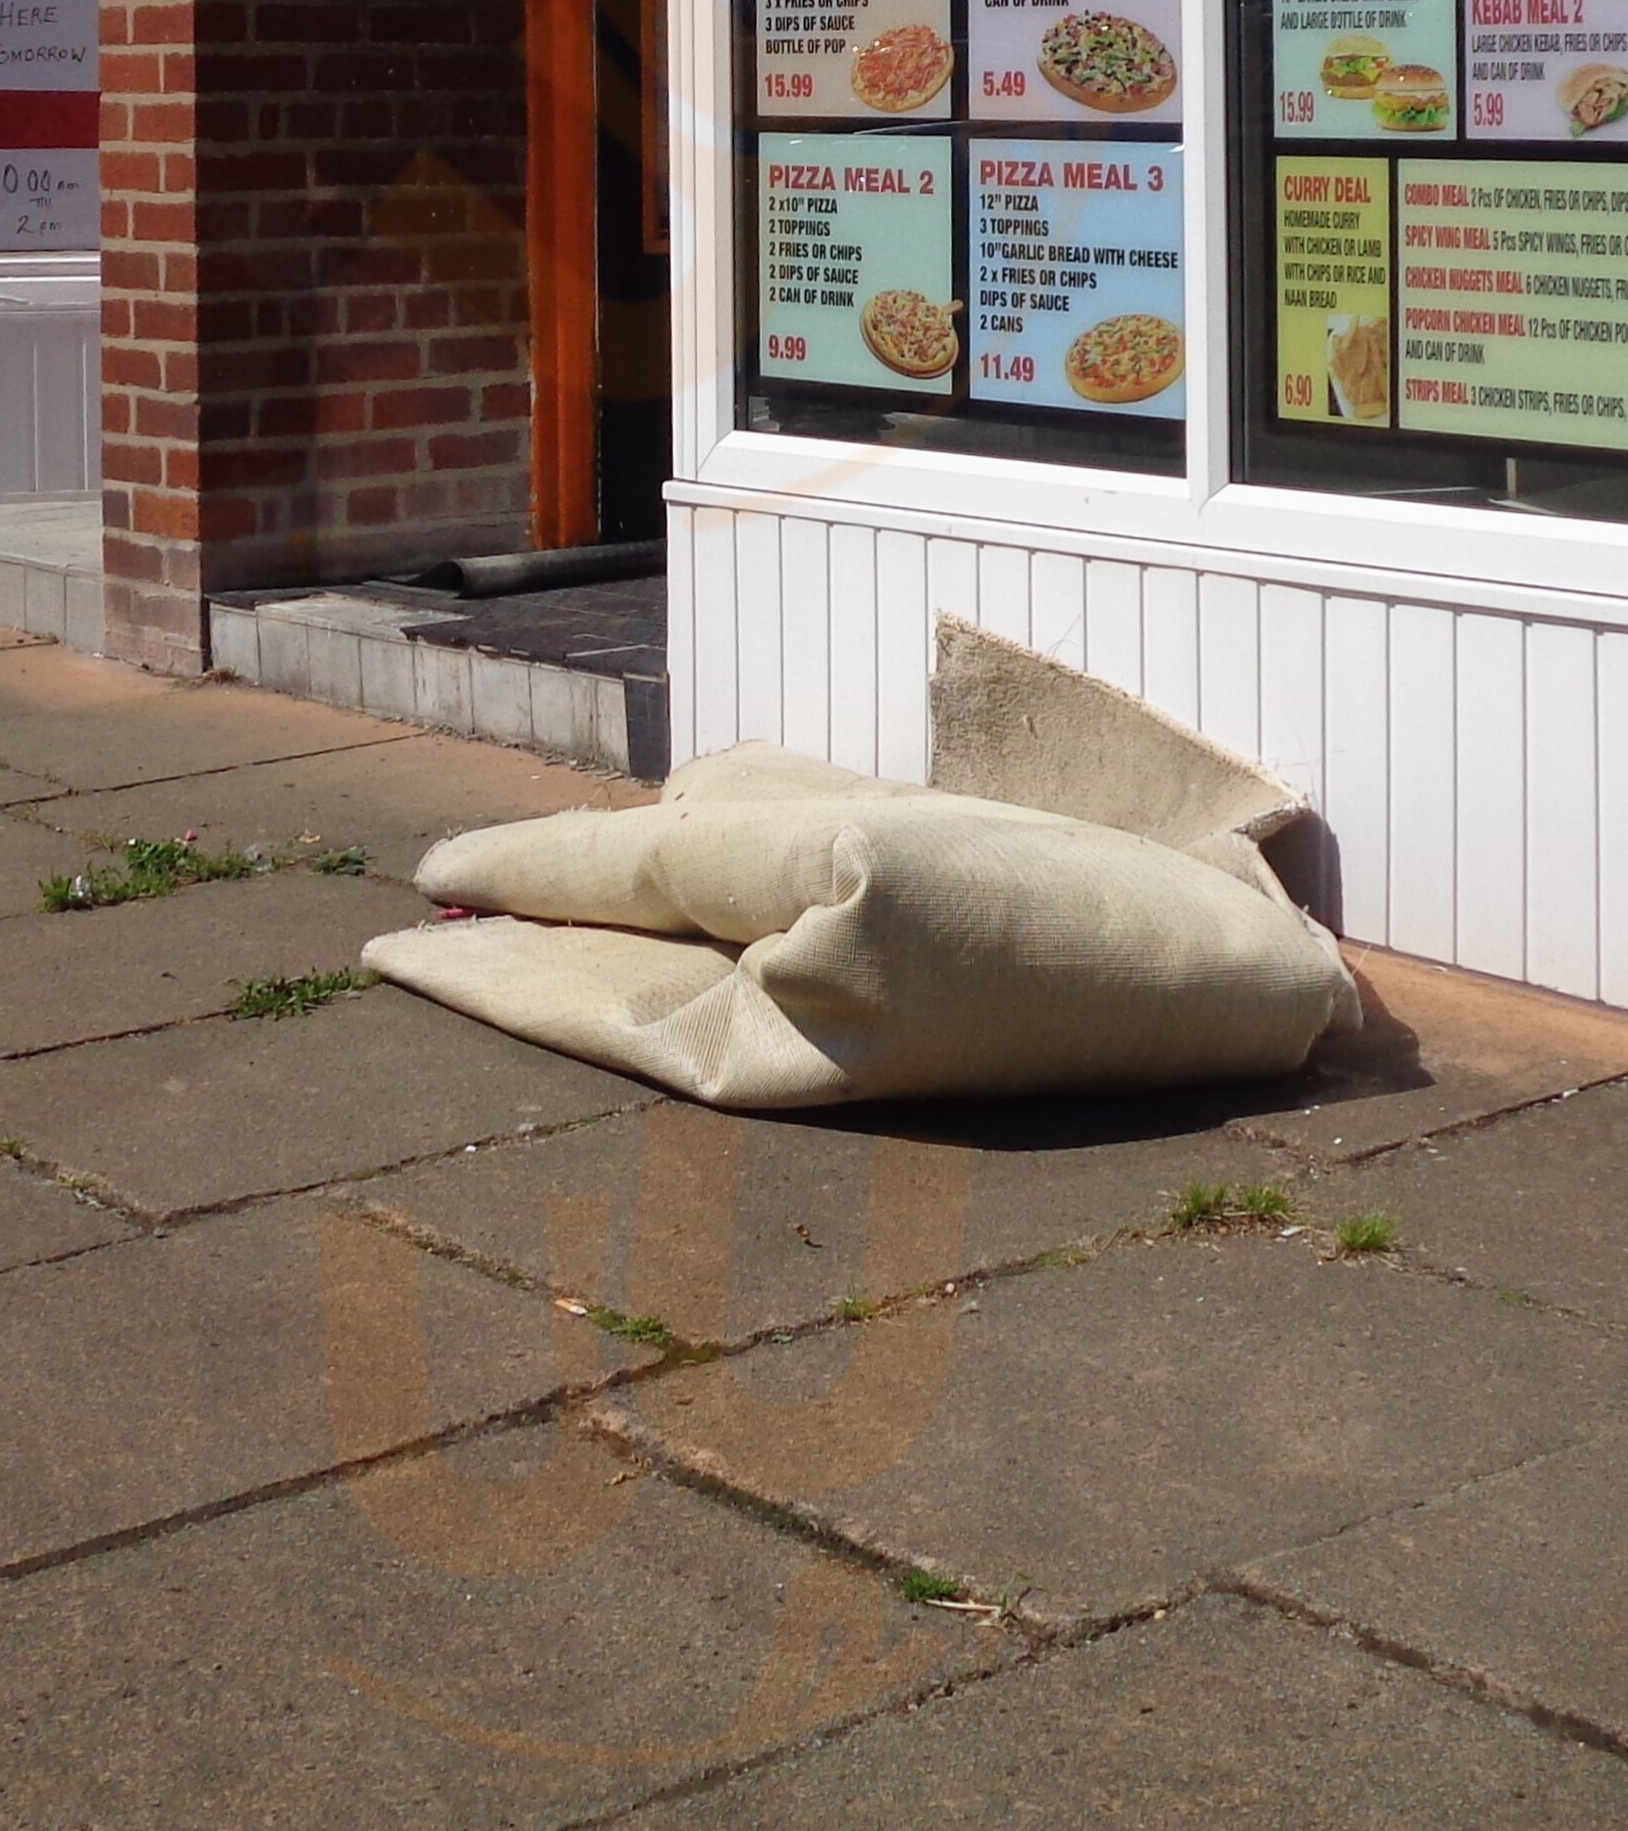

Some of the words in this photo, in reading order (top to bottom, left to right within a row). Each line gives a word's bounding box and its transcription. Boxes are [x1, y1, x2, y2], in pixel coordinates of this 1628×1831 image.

[766, 39, 804, 55] BOTTLE
[807, 39, 822, 54] OF
[824, 38, 846, 54] POP
[764, 73, 813, 98] 15.99
[982, 71, 1025, 97] 5.49
[1279, 90, 1315, 125] 15.99
[1473, 93, 1504, 128] 5.99
[769, 164, 836, 191] PIZZA
[844, 167, 910, 194] MEAL
[919, 170, 934, 195] 2
[980, 160, 1054, 187] PIZZA
[1064, 162, 1137, 190] MEAL
[1147, 166, 1164, 191] 3
[1284, 175, 1331, 202] CURRY
[1334, 176, 1372, 204] DEAL
[1405, 183, 1439, 207] COMBO
[1442, 185, 1469, 208] MEAL
[768, 335, 806, 361] 9.99
[980, 353, 1035, 382] 11.49
[1284, 375, 1313, 407] 6.90
